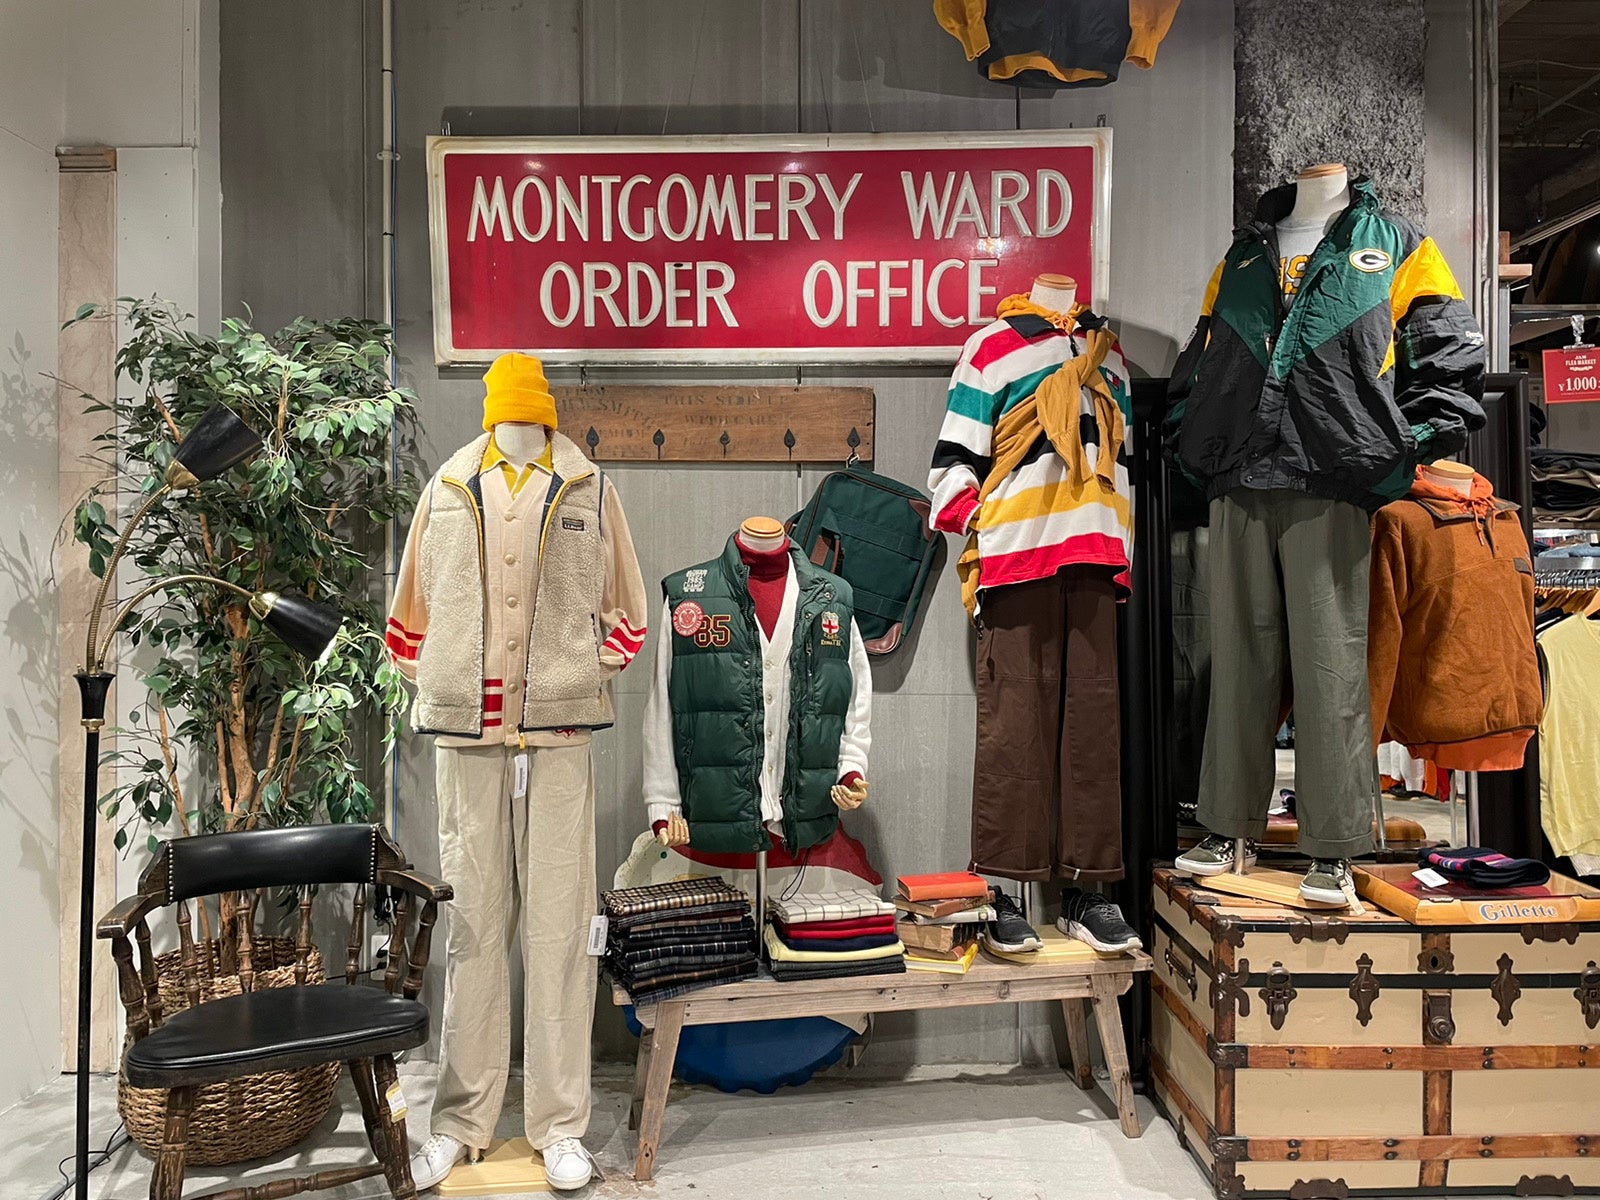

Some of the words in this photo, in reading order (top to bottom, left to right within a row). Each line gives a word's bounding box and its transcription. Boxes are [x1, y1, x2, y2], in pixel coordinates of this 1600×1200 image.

[466, 172, 863, 243] MONTGOMERY
[900, 168, 1074, 240] WARD
[539, 260, 740, 328] ORDER
[802, 258, 999, 328] OFFICE
[694, 614, 731, 648] 85
[1480, 903, 1557, 921] Gillette
